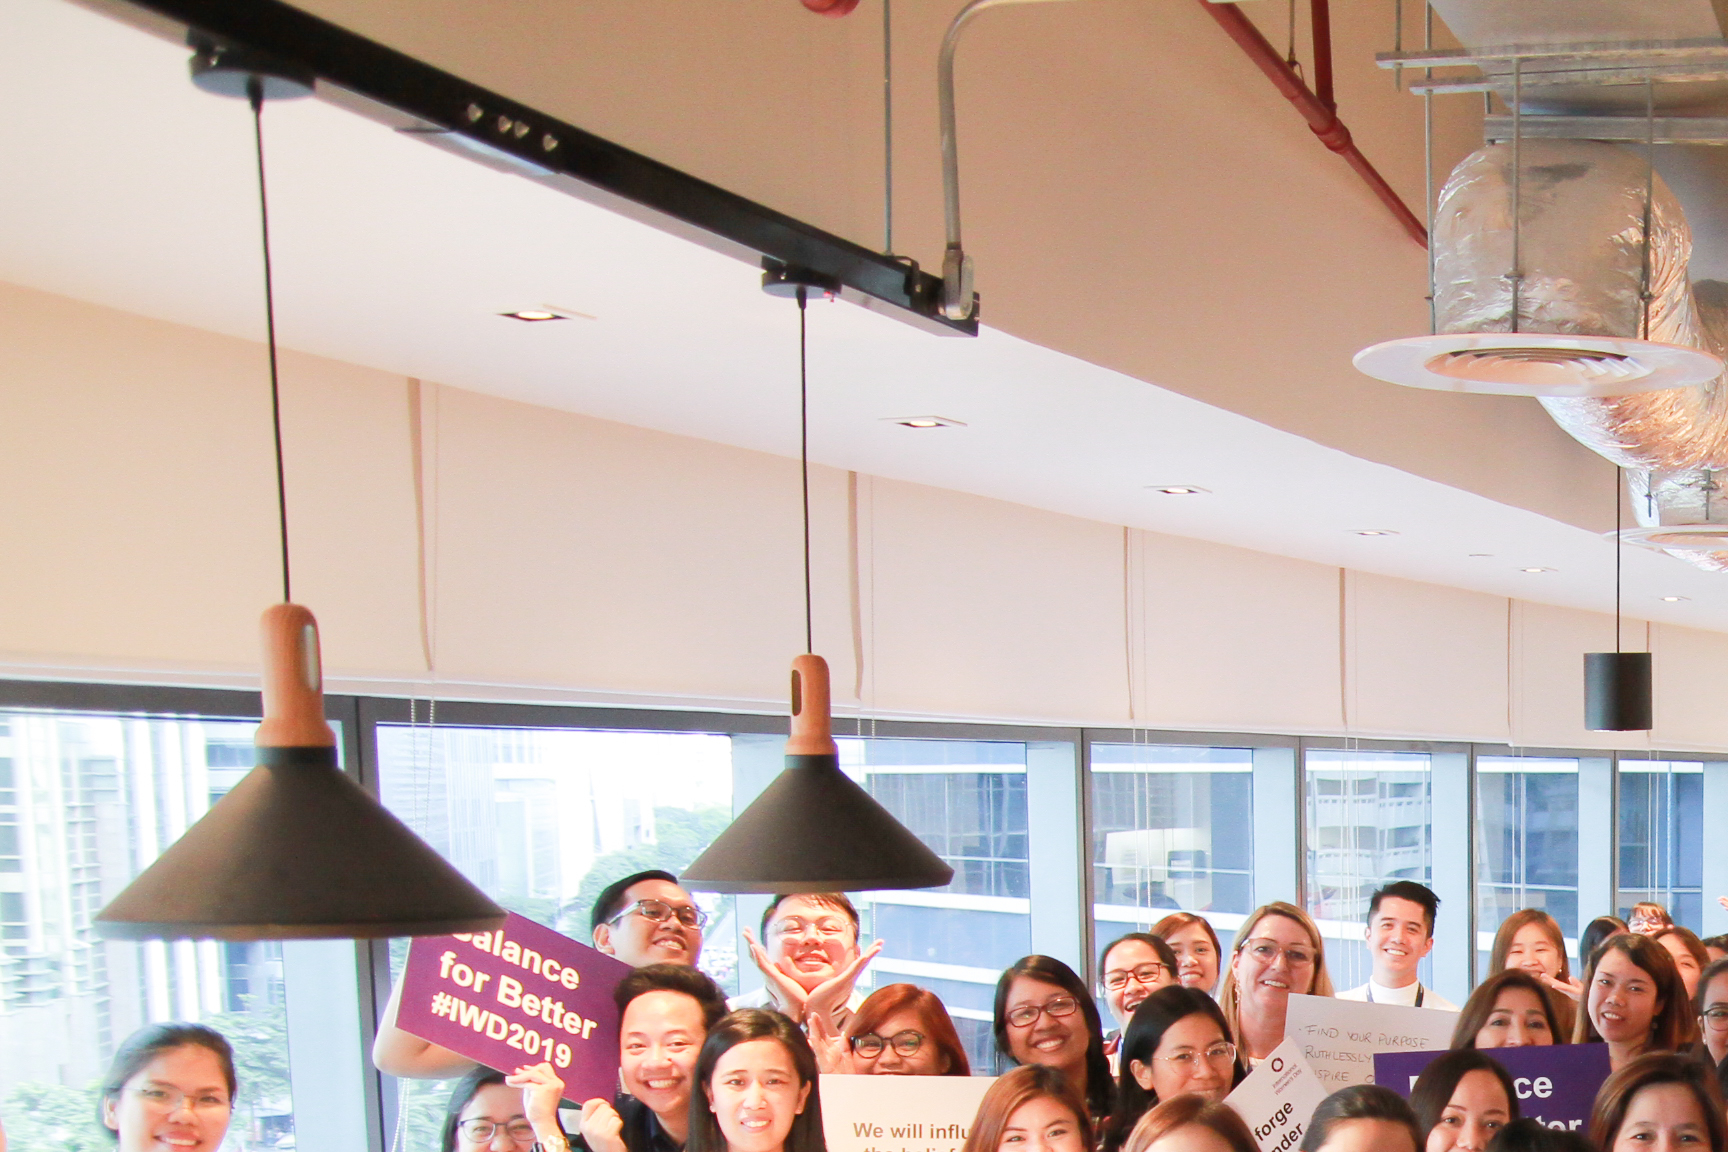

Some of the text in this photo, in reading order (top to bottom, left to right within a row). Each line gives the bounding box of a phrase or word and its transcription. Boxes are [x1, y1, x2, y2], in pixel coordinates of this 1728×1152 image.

[439, 950, 598, 1039] for Better
[430, 991, 572, 1069] #IWD2019
[1304, 1024, 1430, 1049] FIND YOUR PURPOSE
[1304, 1045, 1373, 1064] RUTHLESSLY
[853, 1122, 884, 1138] We
[890, 1123, 923, 1139] will
[1254, 1101, 1294, 1142] forge
